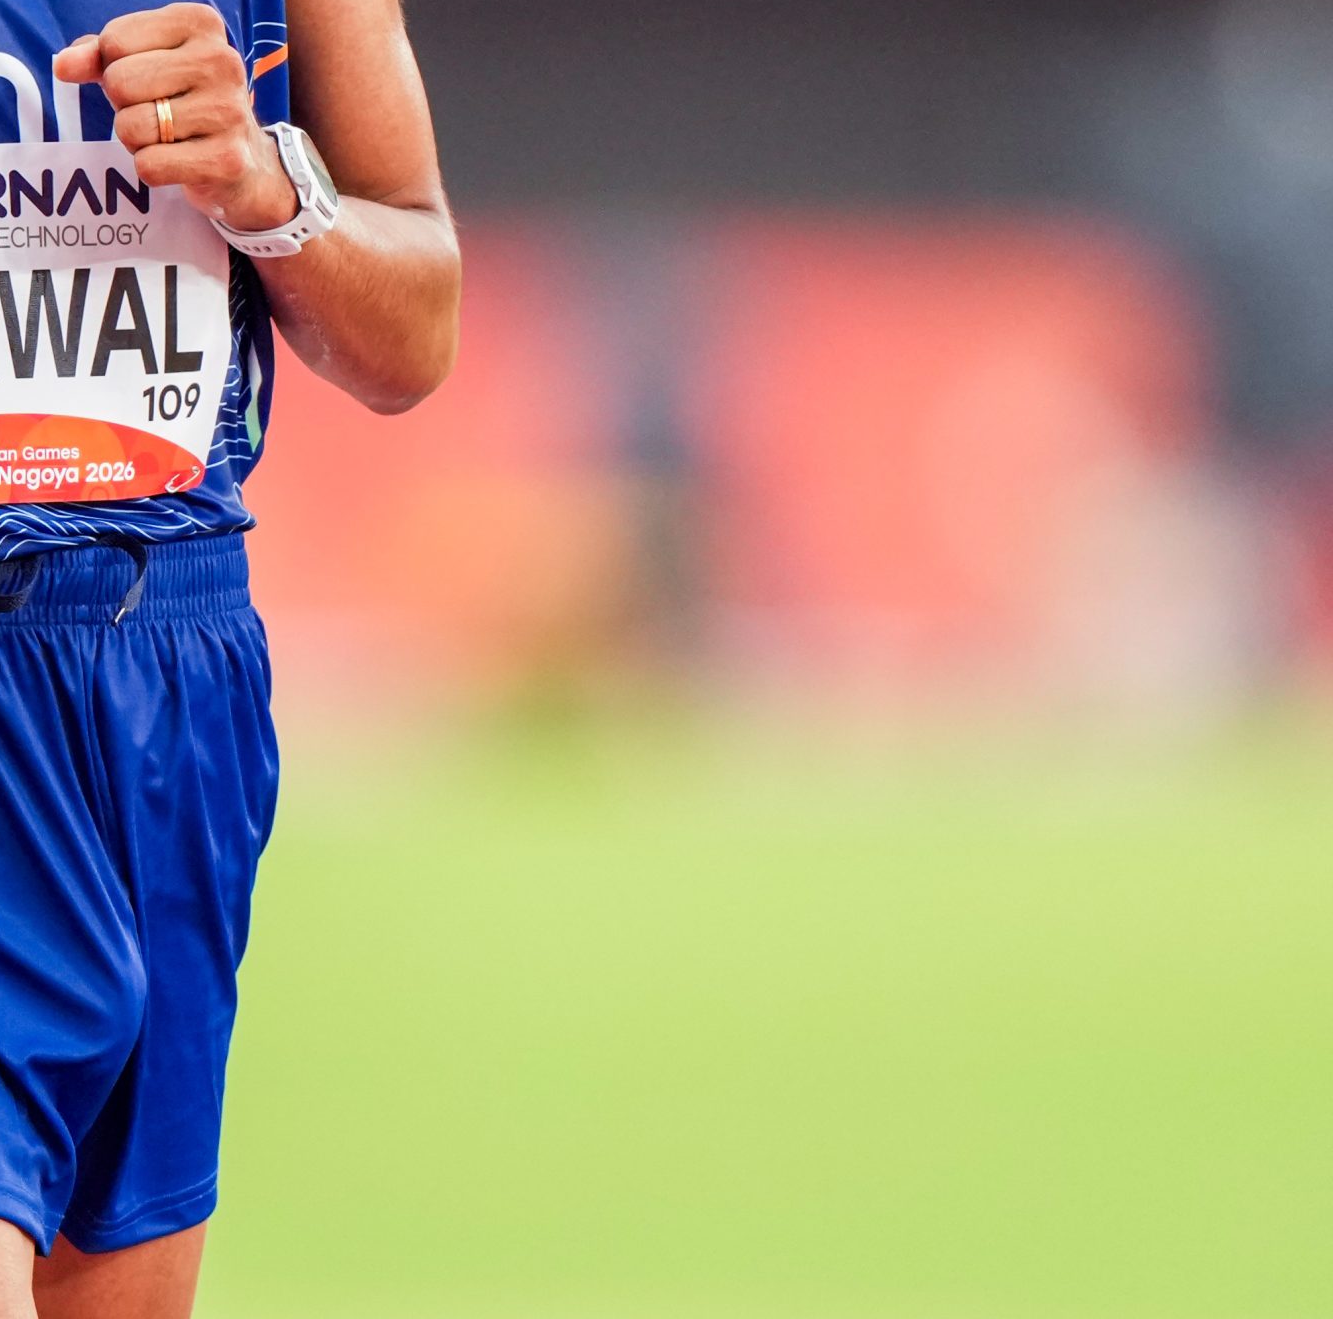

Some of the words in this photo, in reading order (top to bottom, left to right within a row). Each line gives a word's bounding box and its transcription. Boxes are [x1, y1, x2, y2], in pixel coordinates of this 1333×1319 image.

[143, 383, 200, 422] 109
[22, 446, 80, 461] Games
[86, 461, 135, 483] 2026
